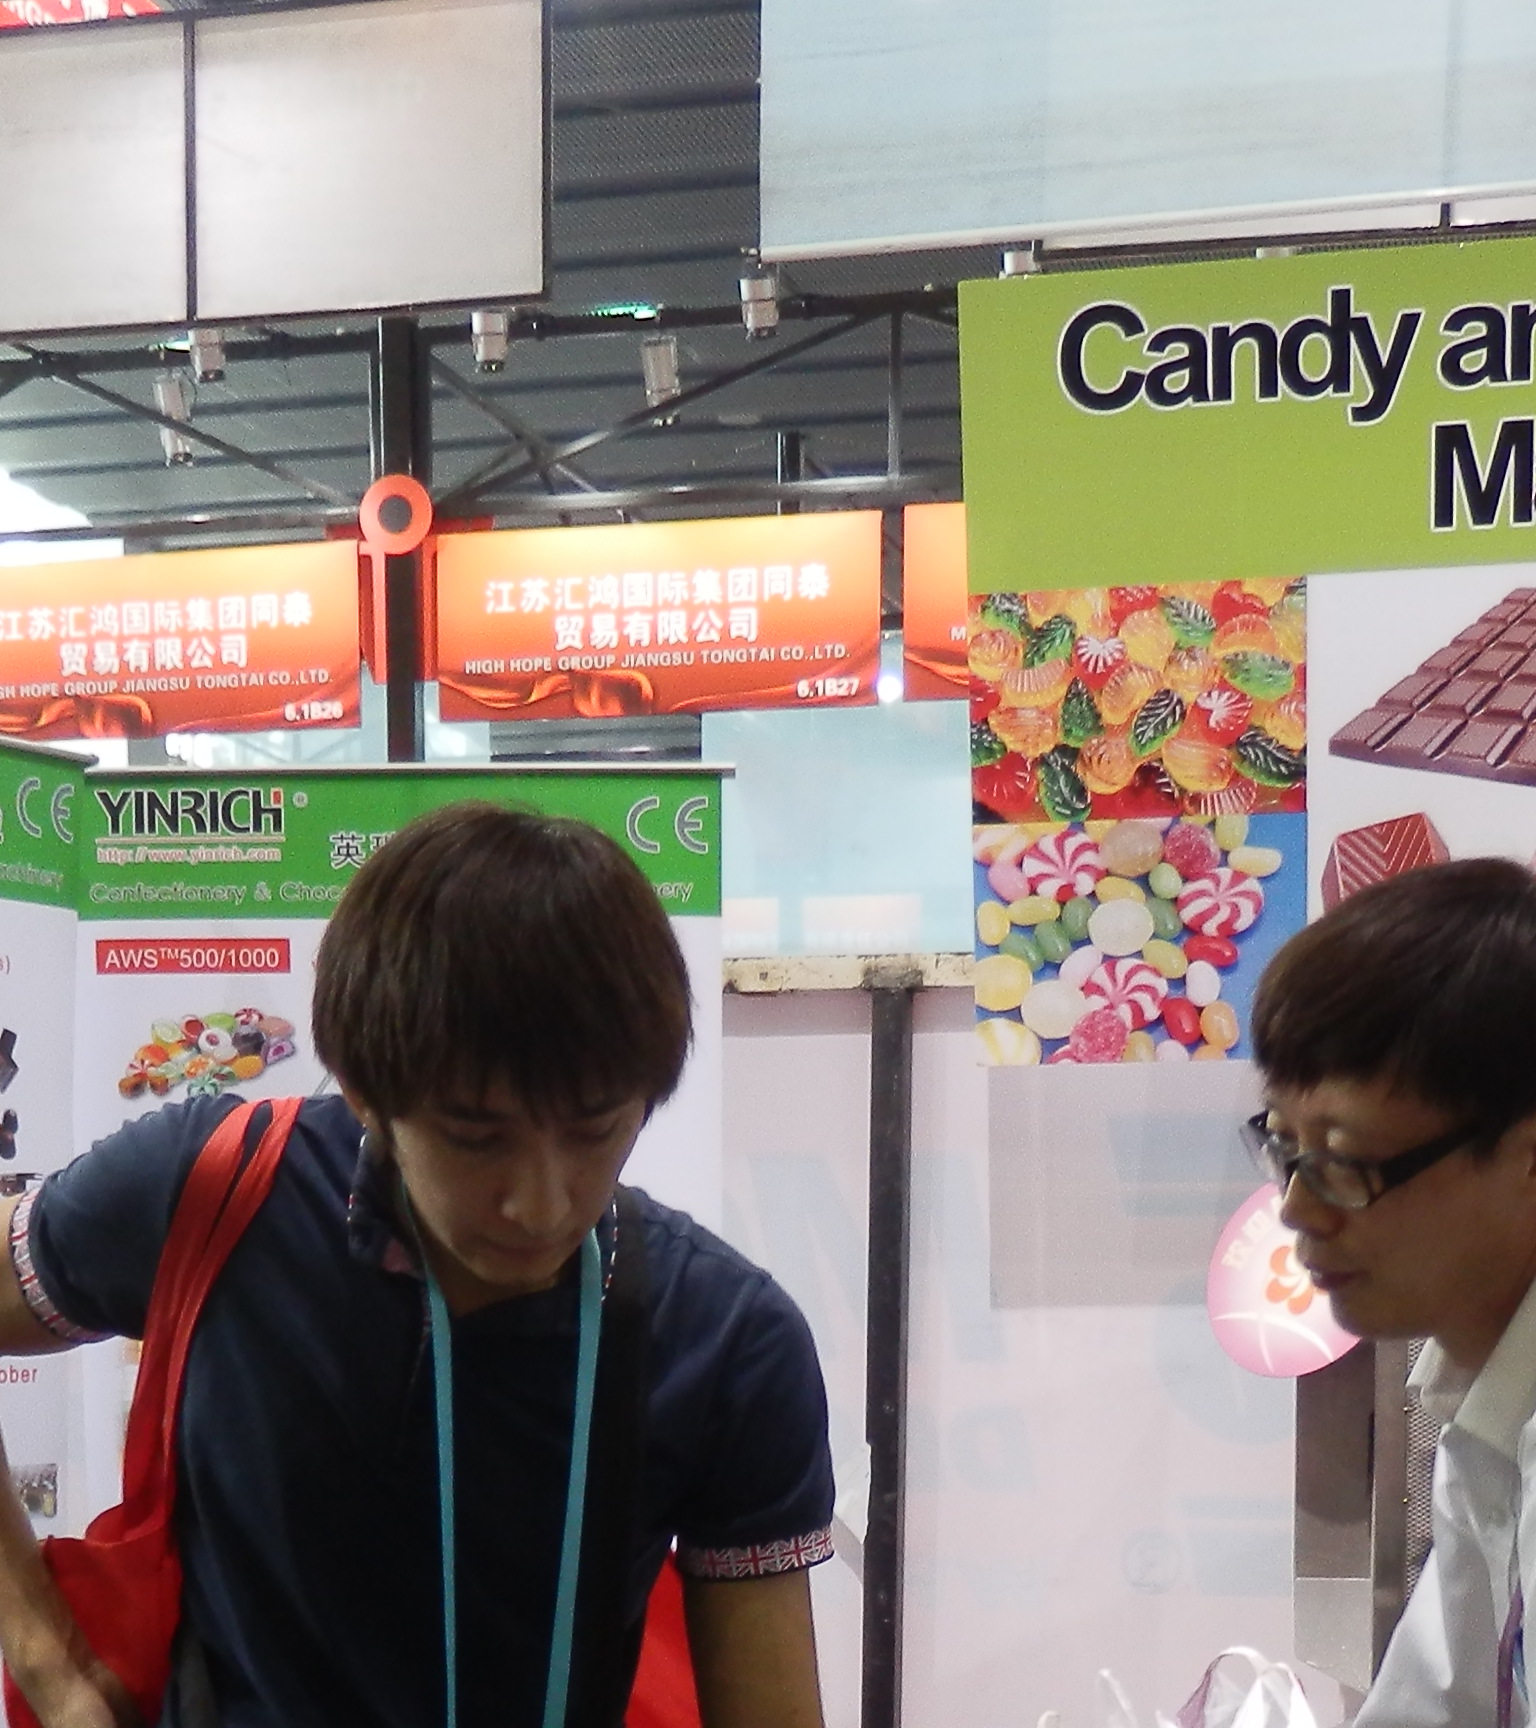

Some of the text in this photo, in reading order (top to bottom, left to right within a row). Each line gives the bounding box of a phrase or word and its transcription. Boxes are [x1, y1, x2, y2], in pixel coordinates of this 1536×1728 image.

[1061, 287, 1424, 422] Candy
[485, 564, 831, 614] 江苏汇鸿国际集团同泰
[554, 608, 760, 651] 贸易有限公司
[60, 634, 248, 677] 贸易有限公司
[465, 660, 505, 674] HIGH
[510, 657, 552, 672] HOPE
[558, 655, 616, 671] GROUP
[621, 651, 695, 669] JIANGSU
[700, 647, 776, 665] TONGTAI
[20, 683, 58, 698] HOPE
[64, 680, 117, 696] GROUP
[122, 677, 190, 694] JIANGSU
[196, 673, 264, 690] TONGTAI
[796, 678, 859, 698] 6.1B27
[95, 788, 285, 836] YINRICH
[90, 882, 246, 905] Confectionery
[254, 882, 272, 901] &
